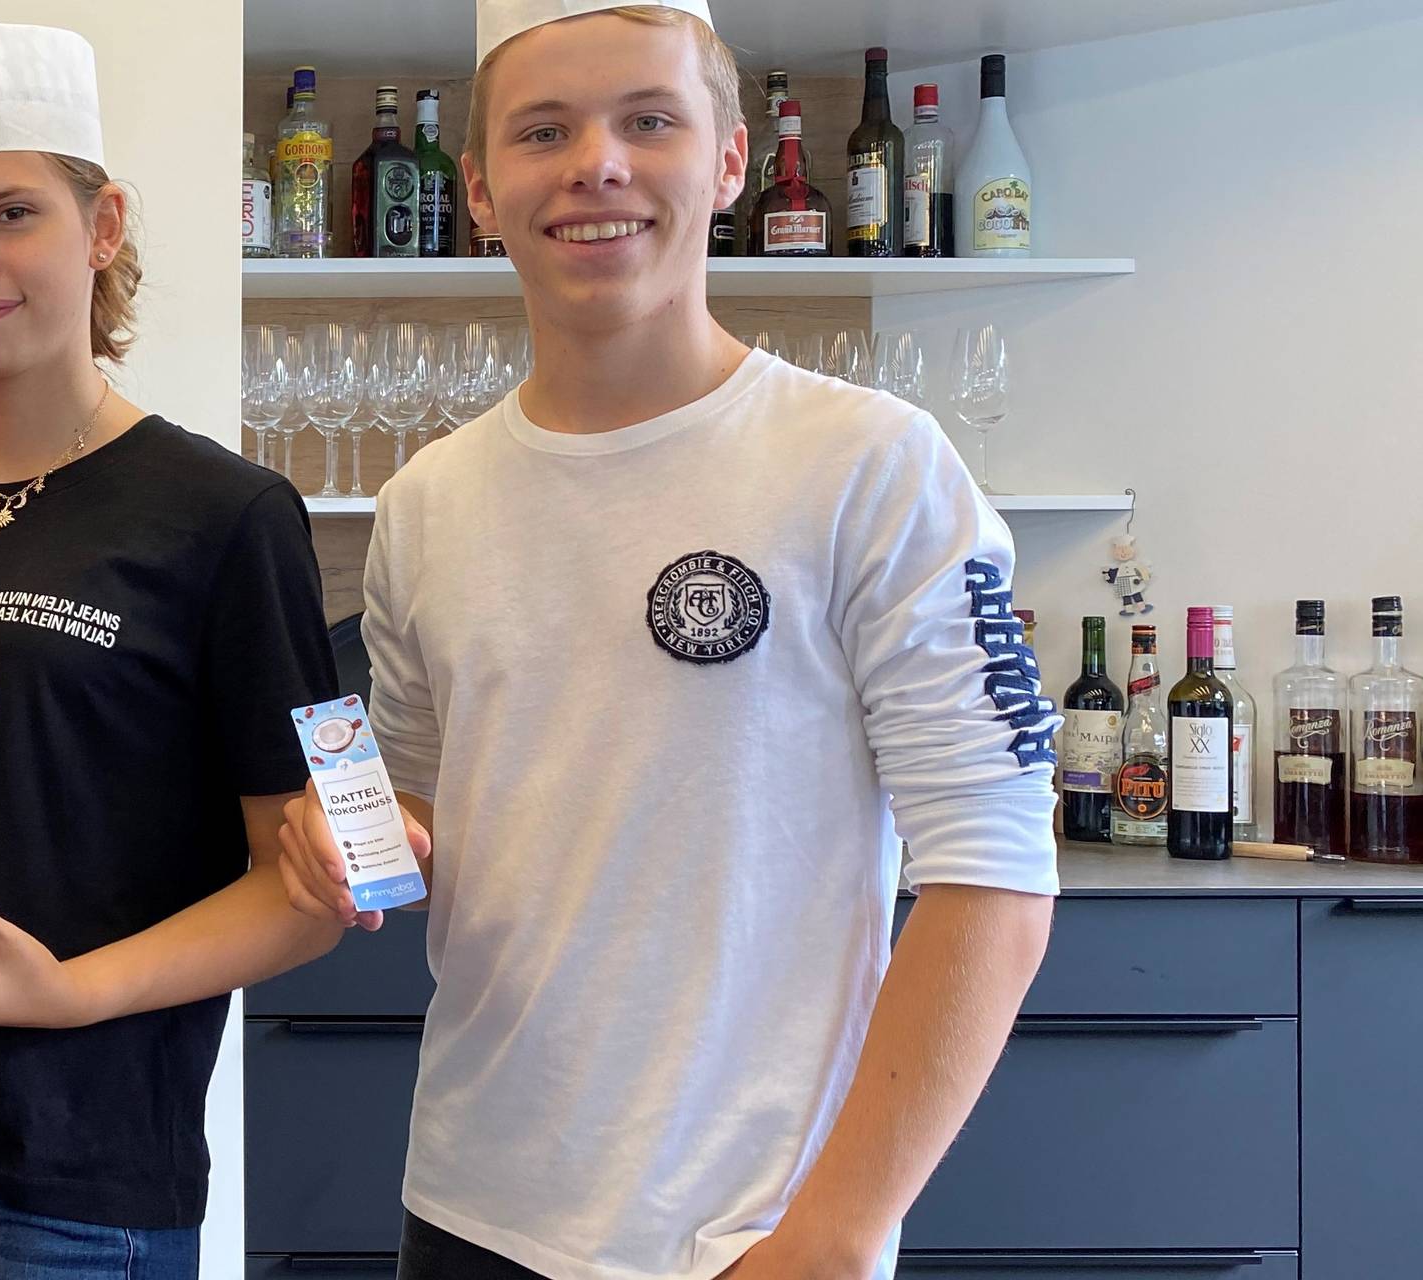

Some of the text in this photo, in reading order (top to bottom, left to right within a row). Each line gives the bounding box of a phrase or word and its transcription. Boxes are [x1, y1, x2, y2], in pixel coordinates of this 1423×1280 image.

[420, 193, 450, 203] ROAL
[422, 204, 452, 214] POTO
[729, 568, 760, 604] FITCH
[20, 608, 65, 632] KLEIN
[73, 604, 122, 631] JEANS
[691, 628, 719, 637] 1892
[665, 633, 747, 655] NEW YORK
[1190, 737, 1211, 753] XX
[328, 795, 393, 816] KOKOSNUSS
[330, 786, 383, 805] DATTEL
